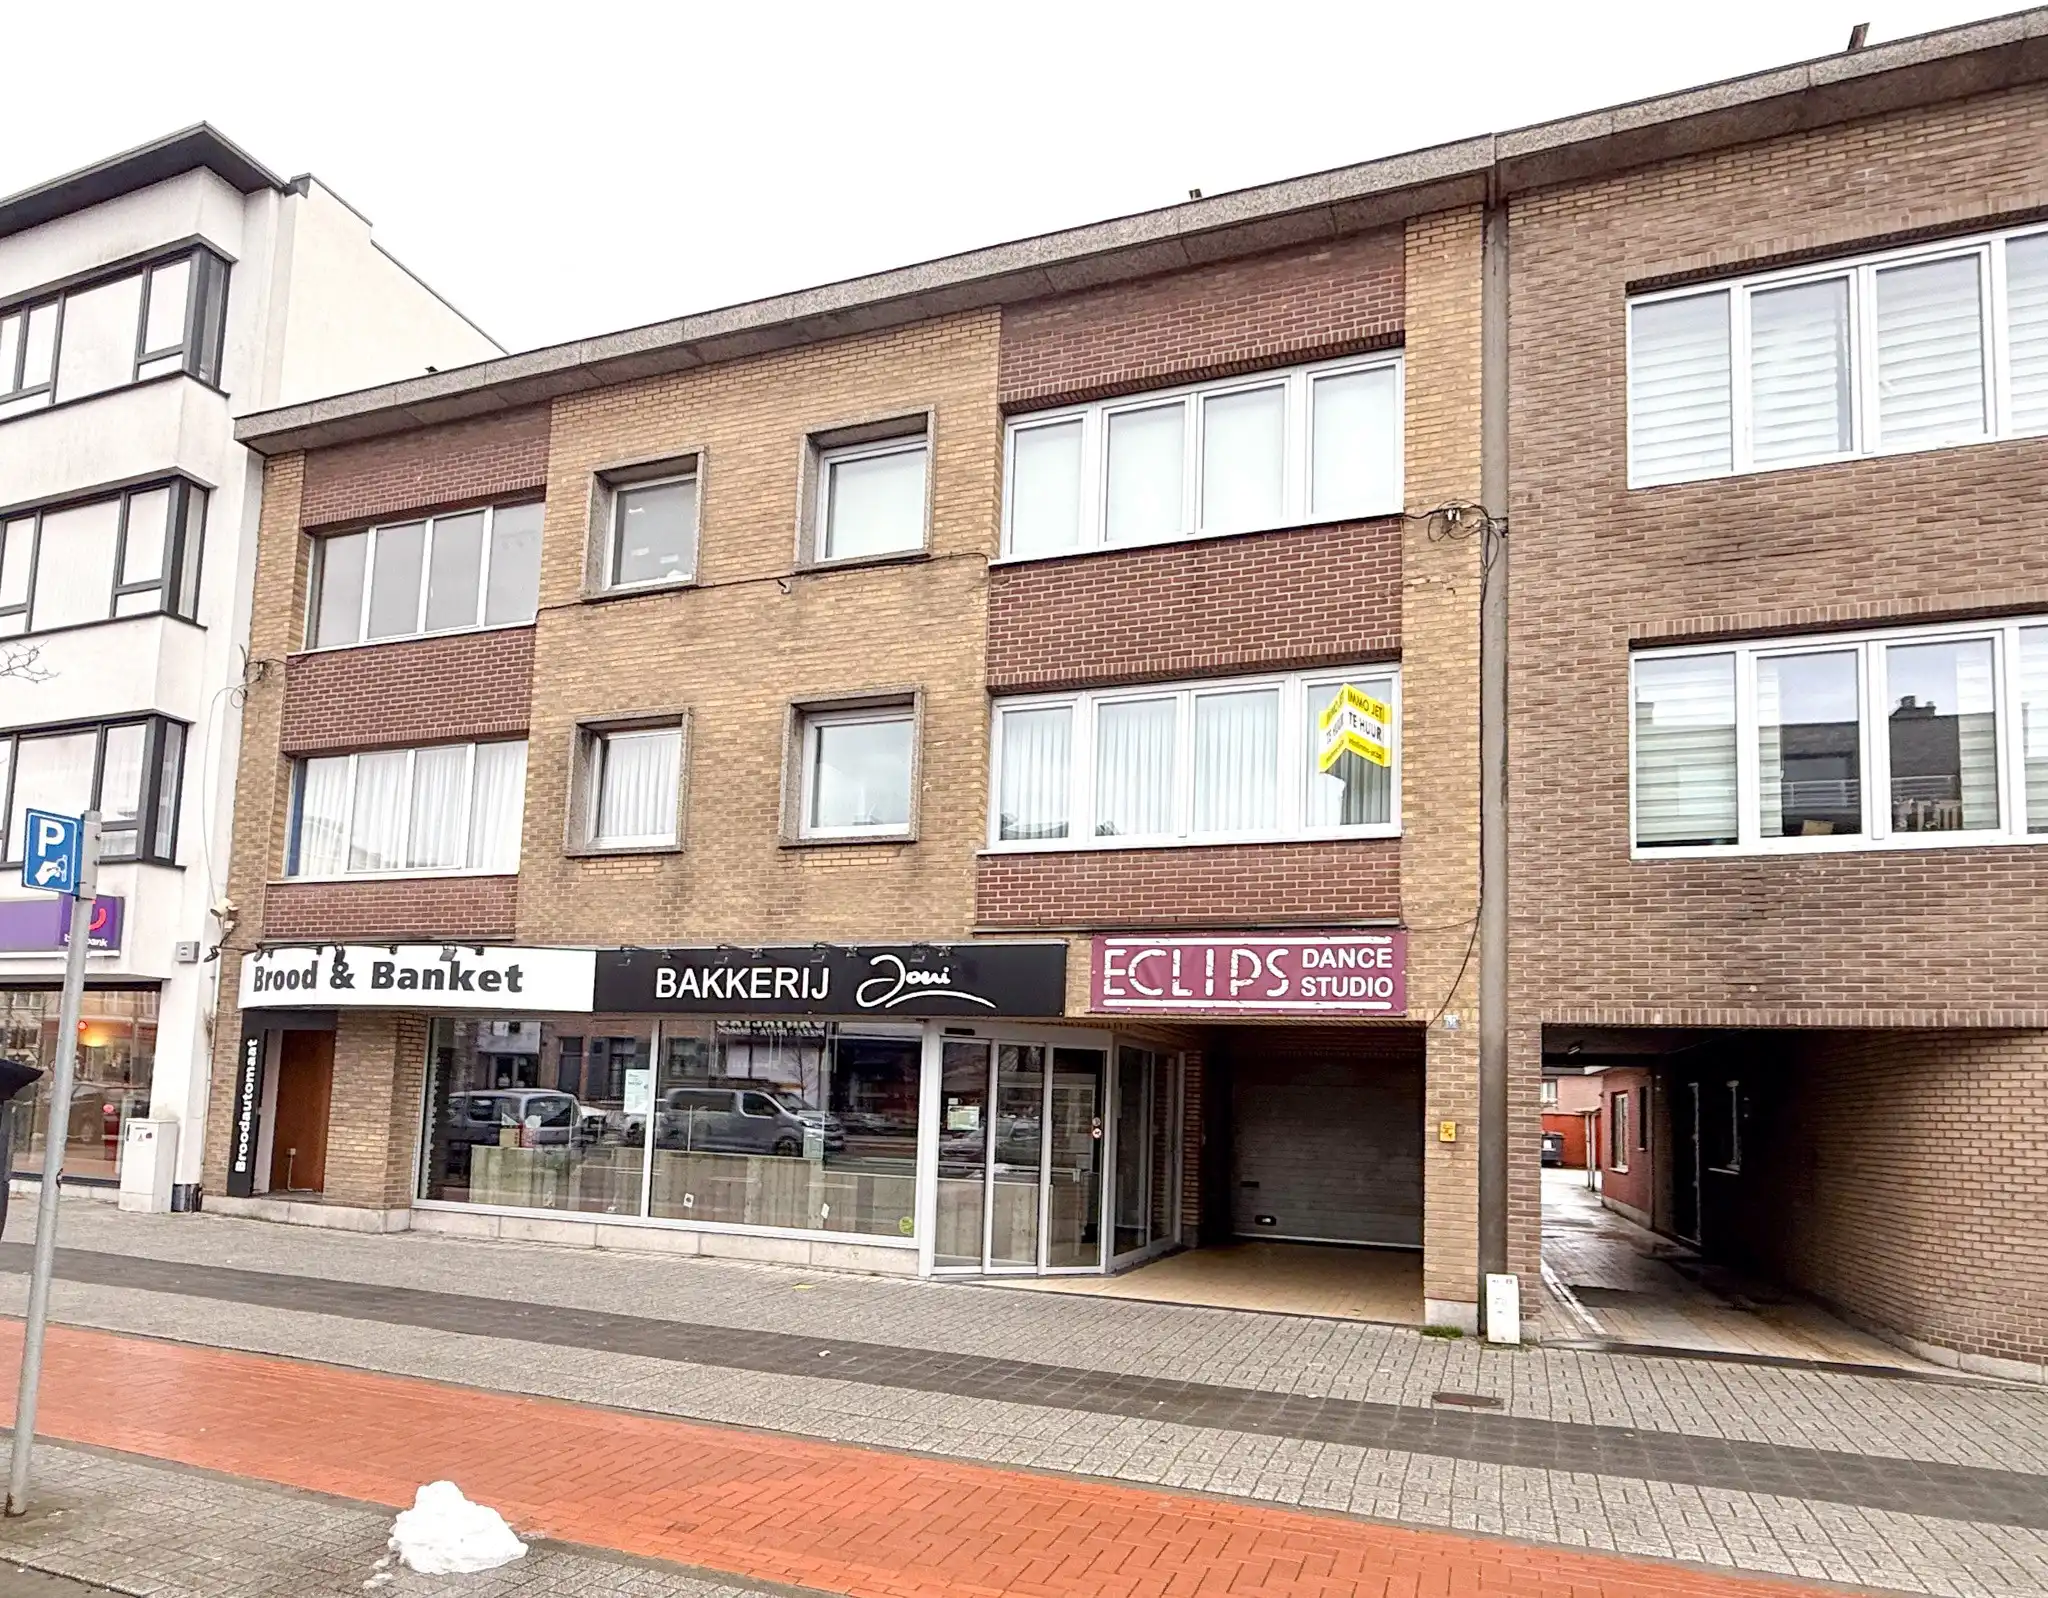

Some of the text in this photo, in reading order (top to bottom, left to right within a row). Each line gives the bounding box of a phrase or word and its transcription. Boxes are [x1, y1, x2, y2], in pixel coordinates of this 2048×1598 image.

[1348, 688, 1369, 712] IMMO
[1371, 703, 1383, 720] JET
[1348, 712, 1357, 728] TE
[1359, 719, 1382, 742] HUUR
[37, 818, 66, 857] P
[1102, 948, 1290, 998] ECLIPS
[1302, 948, 1393, 969] DANCE
[253, 960, 524, 993] Brood & Banket
[655, 967, 830, 1000] BAKKERIJ
[1300, 976, 1394, 998] STUDIO
[235, 1038, 258, 1173] Broodautomaat
